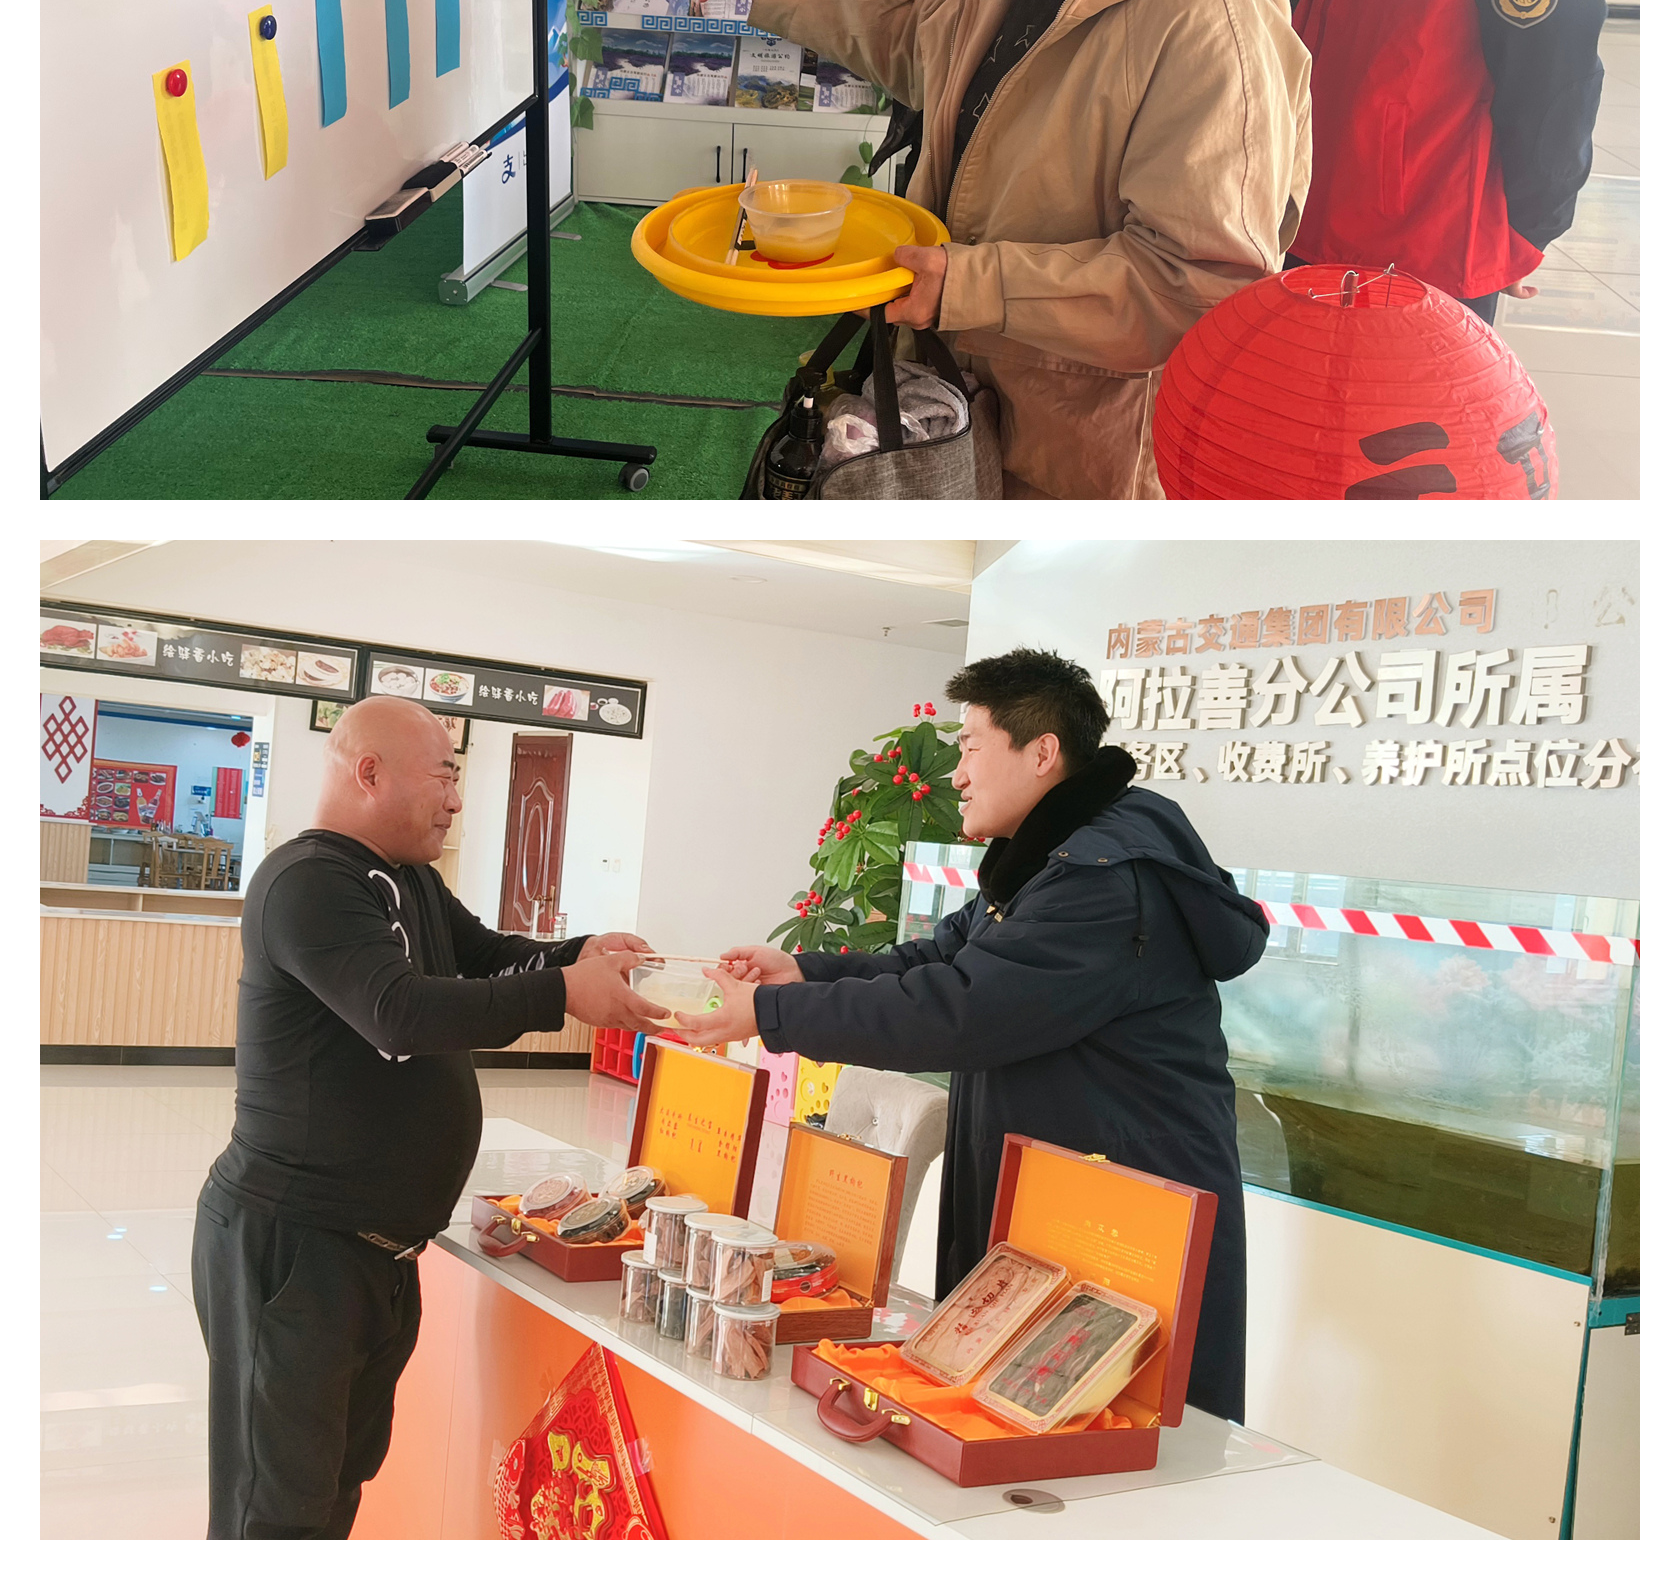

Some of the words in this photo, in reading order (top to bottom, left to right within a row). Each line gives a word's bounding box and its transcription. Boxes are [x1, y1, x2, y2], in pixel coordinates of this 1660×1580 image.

[1105, 588, 1498, 660] 内蒙古交通集团有限公司
[1098, 644, 1594, 732] 阿拉善分公司所属
[1098, 737, 1640, 791] 务区、收费所、养护所点位分
